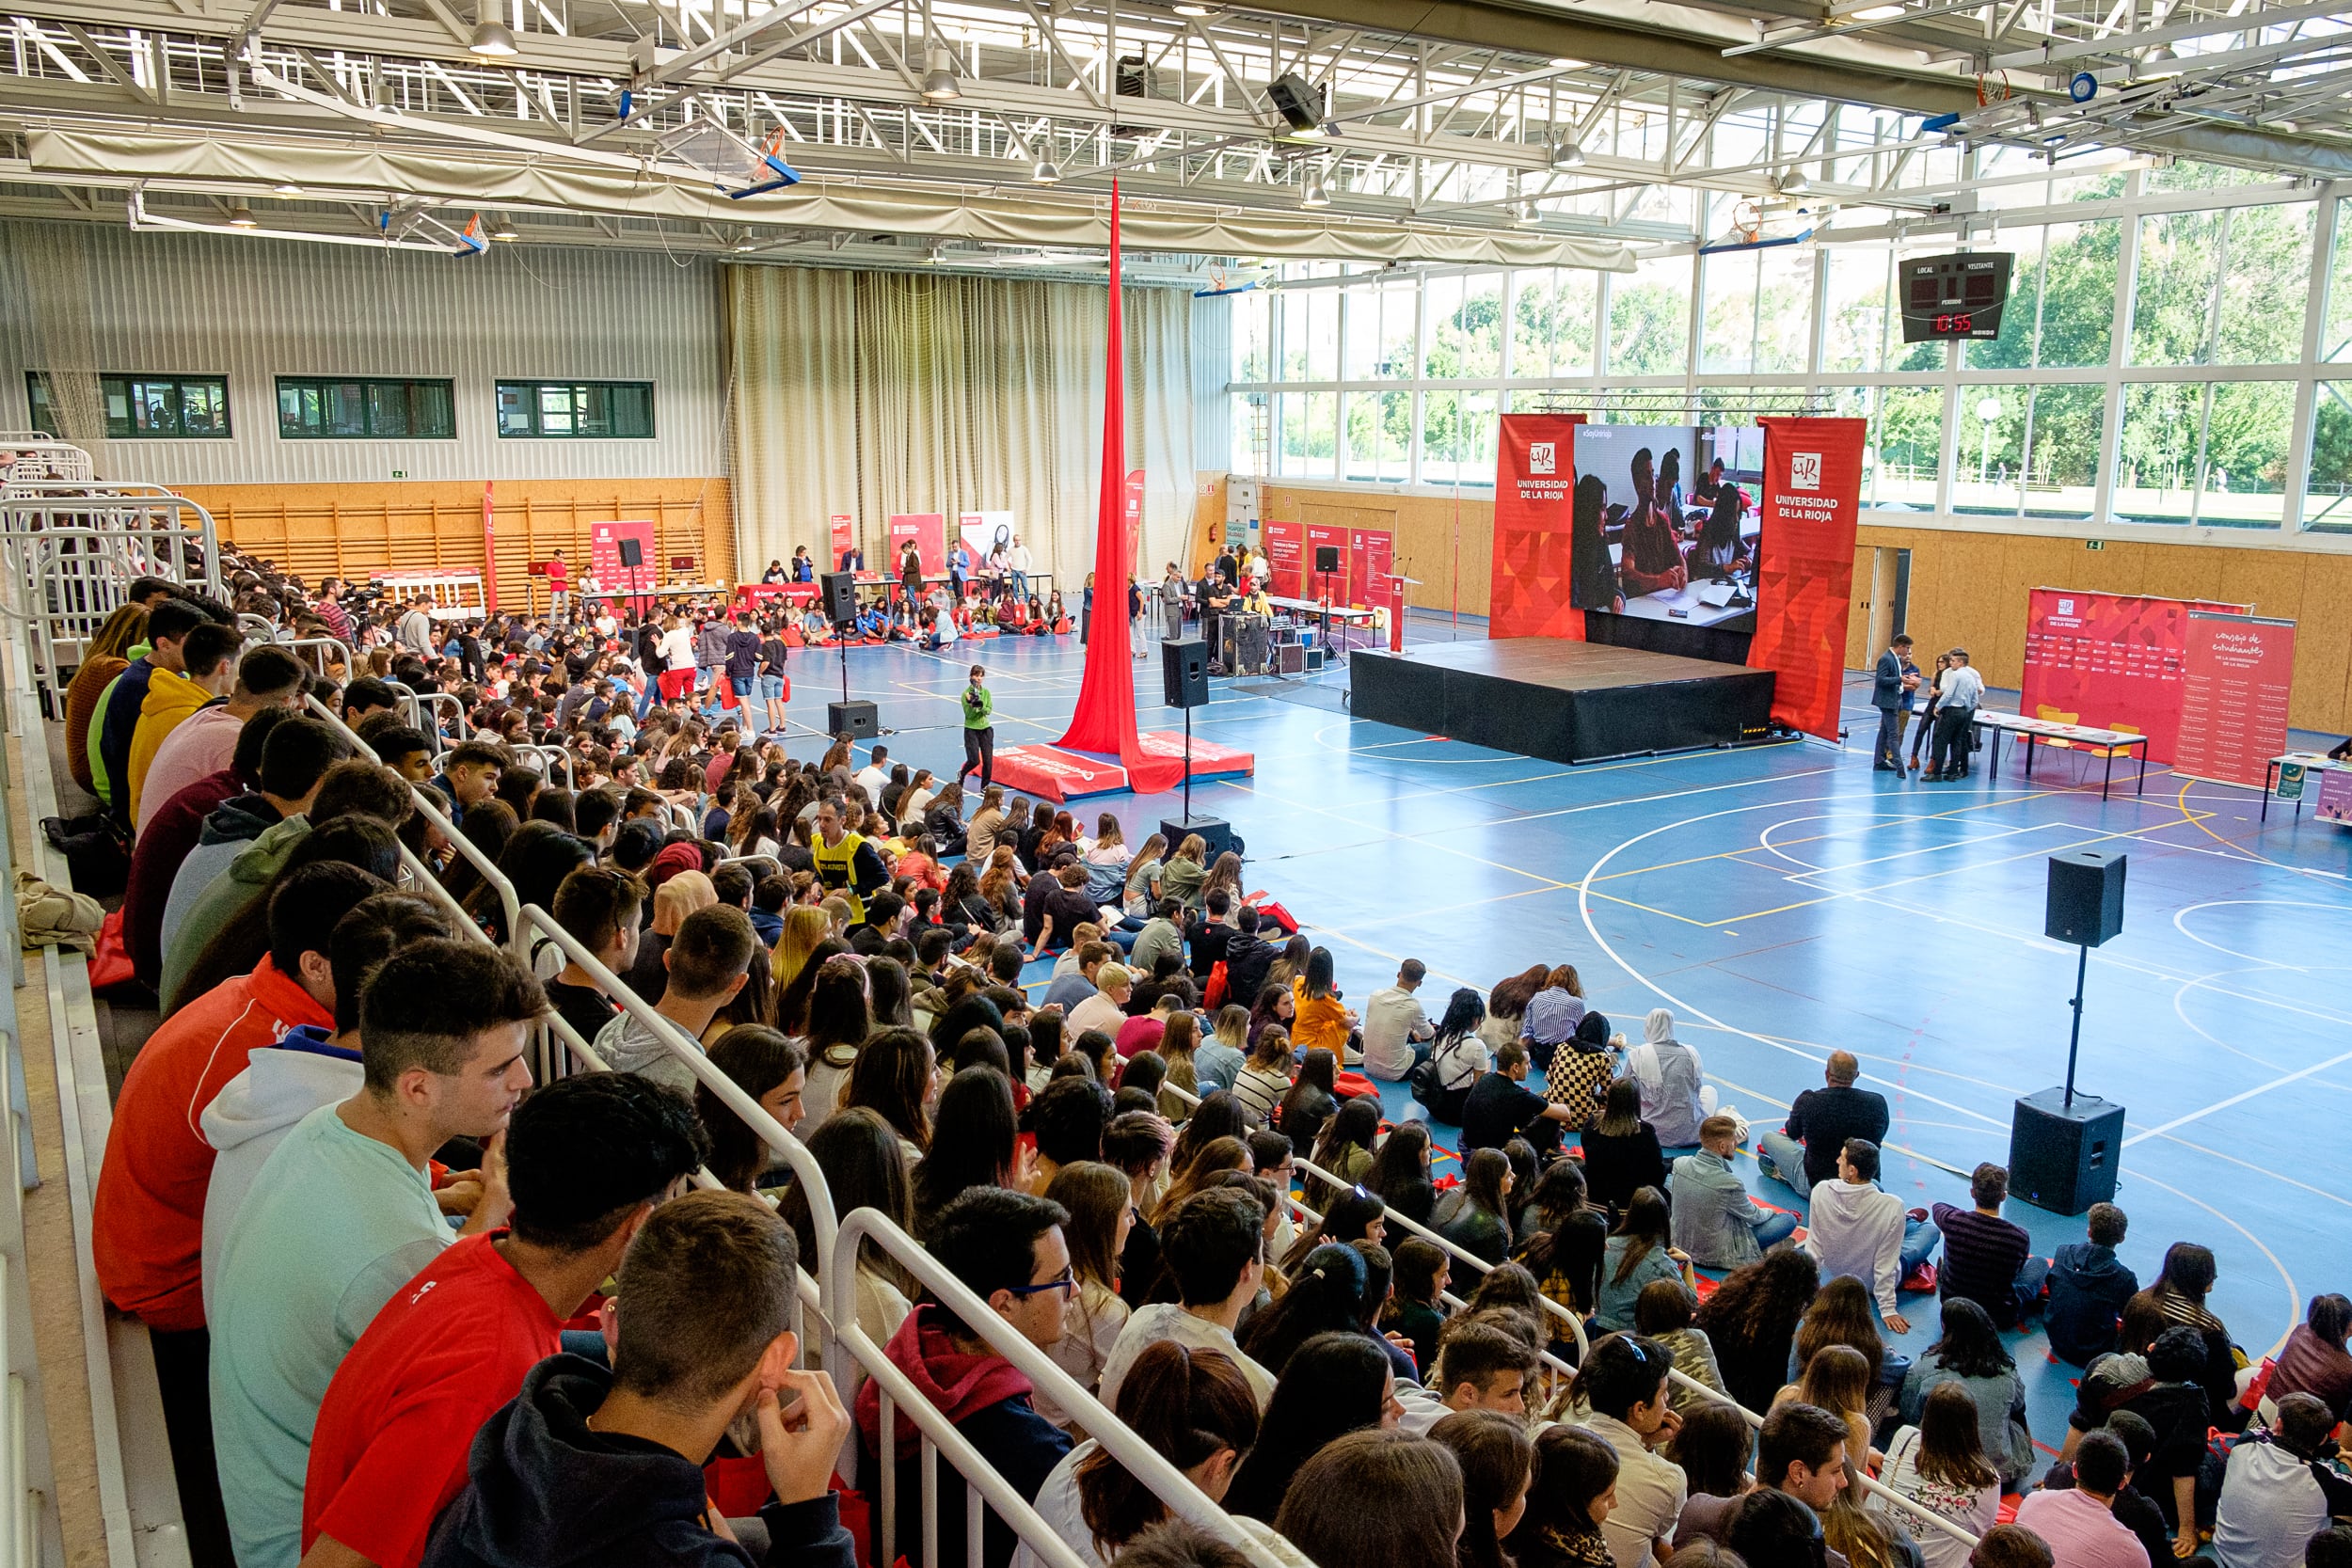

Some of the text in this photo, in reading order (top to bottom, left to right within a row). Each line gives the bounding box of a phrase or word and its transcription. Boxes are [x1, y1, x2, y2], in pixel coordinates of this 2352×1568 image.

[1968, 261, 1994, 270] VISITANTE
[1936, 314, 1971, 332] 10:55
[1517, 480, 1568, 488] UNIVERSIDAD
[1544, 491, 1564, 501] RIOJA
[1775, 495, 1838, 509] UNIVERSIDAD
[1779, 508, 1832, 522] DE LA RIOJA
[2215, 633, 2262, 644] consejo de
[2212, 643, 2264, 657] estudiantes
